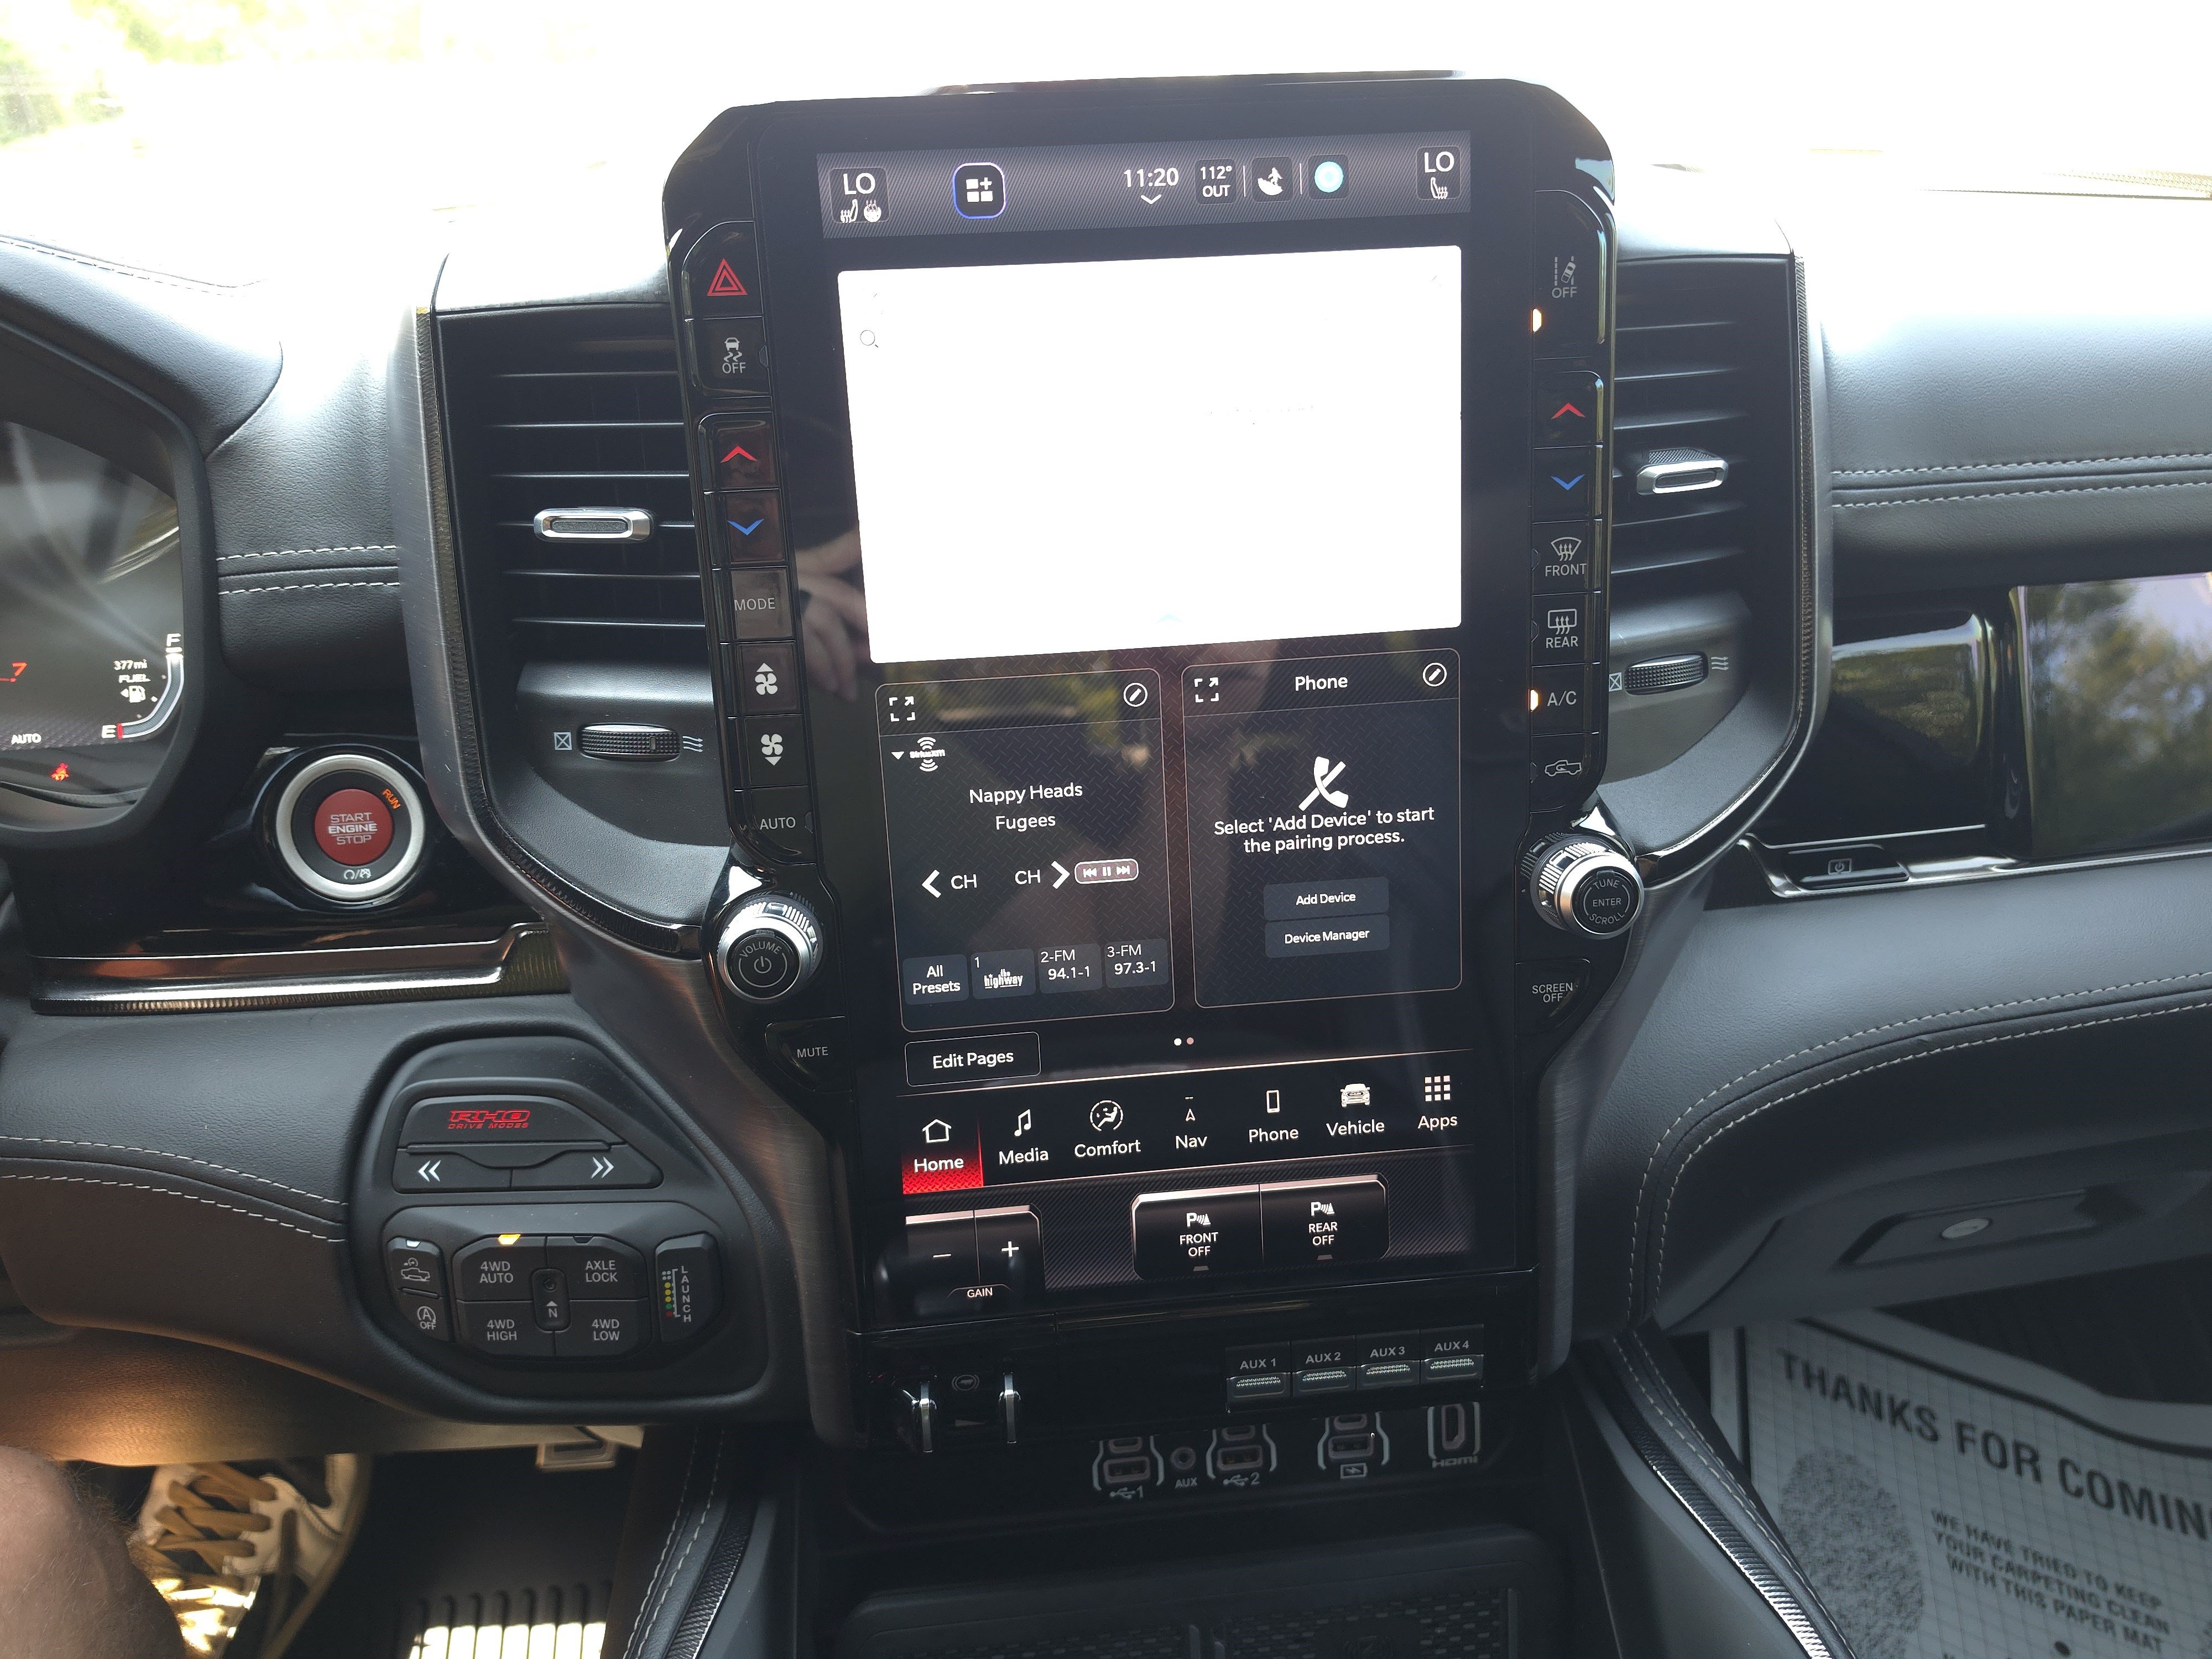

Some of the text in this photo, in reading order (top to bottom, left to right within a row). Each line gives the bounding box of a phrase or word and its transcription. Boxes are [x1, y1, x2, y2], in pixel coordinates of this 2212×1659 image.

[1424, 152, 1454, 174] LO
[1124, 167, 1179, 188] 11:20
[1200, 165, 1232, 181] 112°
[843, 173, 875, 195] LO
[1202, 184, 1230, 198] OUT
[1552, 287, 1578, 299] OFF
[722, 362, 746, 374] OFF
[1545, 563, 1587, 577] FRONT
[734, 598, 776, 611] MODE
[166, 633, 182, 647] F
[1546, 636, 1579, 649] REAR
[12, 662, 28, 676] 7
[1295, 675, 1348, 691] Phone
[1547, 691, 1577, 707] A/C
[101, 724, 117, 739] E
[11, 733, 42, 745] AUTO
[381, 788, 401, 810] RUN
[969, 782, 1083, 805] Nappy Heads
[330, 812, 372, 823] START
[759, 817, 796, 831] AUTO
[995, 815, 1056, 832] Fugees
[1214, 807, 1434, 836] Select 'Add Device' to start
[327, 822, 378, 834] ENGINE
[336, 834, 372, 846] STOP
[1244, 832, 1405, 854] the pairing process.
[951, 874, 978, 889] CH
[1015, 869, 1041, 885] CH
[1593, 878, 1620, 890] TUNE
[1296, 891, 1356, 906] Add Device
[1592, 898, 1621, 907] ENTER
[1588, 912, 1625, 925] SCROLL
[1284, 928, 1370, 945] Device Manager
[739, 941, 782, 958] VOLUME
[1040, 949, 1076, 963] 2-FM
[1107, 944, 1142, 958] 3-FM
[974, 956, 980, 969] 1
[1114, 961, 1156, 975] 97.3-1
[926, 964, 943, 978] All
[1048, 966, 1091, 980] 94.1-1
[912, 980, 961, 995] Presets
[984, 973, 1024, 989] highway
[1532, 982, 1573, 995] SCREEN
[1542, 993, 1563, 1003] OFF
[797, 1046, 829, 1058] MUTE
[932, 1051, 1014, 1070] Edit Pages
[450, 1109, 531, 1123] RHO
[1417, 1114, 1458, 1131] Apps
[1248, 1126, 1300, 1144] Phone
[1326, 1119, 1386, 1137] Vehicle
[1074, 1139, 1141, 1158] Comfort
[1175, 1134, 1208, 1150] Nav
[998, 1148, 1049, 1165] Media
[914, 1157, 964, 1173] Home
[1308, 1222, 1338, 1233] REAR
[1179, 1232, 1219, 1245] FRONT
[1312, 1234, 1335, 1246] OFF
[1188, 1245, 1211, 1258] OFF
[480, 1260, 511, 1271] 4WD
[585, 1260, 617, 1271] AXLE
[479, 1272, 514, 1284] AUTO
[585, 1272, 618, 1283] LOCK
[681, 1265, 692, 1323] LAUNCH
[967, 1287, 993, 1298] GAIN
[548, 1307, 558, 1318] N
[420, 1321, 436, 1329] OFF
[487, 1319, 515, 1329] 4WD
[592, 1318, 620, 1329] 4WD
[487, 1329, 518, 1342] HIGH
[593, 1329, 621, 1341] LOW
[1370, 1346, 1406, 1358] AUX 3
[1434, 1340, 1469, 1353] AUX 4
[1239, 1358, 1276, 1370] AUX 1
[1305, 1352, 1341, 1364] AUX 2
[1779, 1348, 2212, 1541] THANKS FOR COMIN
[1175, 1478, 1198, 1489] AUX
[1250, 1472, 1260, 1485] 2
[1136, 1486, 1144, 1498] 1
[1965, 1524, 2013, 1553] HAVE
[2021, 1545, 2077, 1579] TRIED
[2084, 1569, 2109, 1593] TO
[2114, 1582, 2163, 1609] KEEP
[1933, 1527, 2170, 1635] YOUR CARPETING CLEAN
[1947, 1553, 2162, 1655] WITH THIS PAPER MAT
